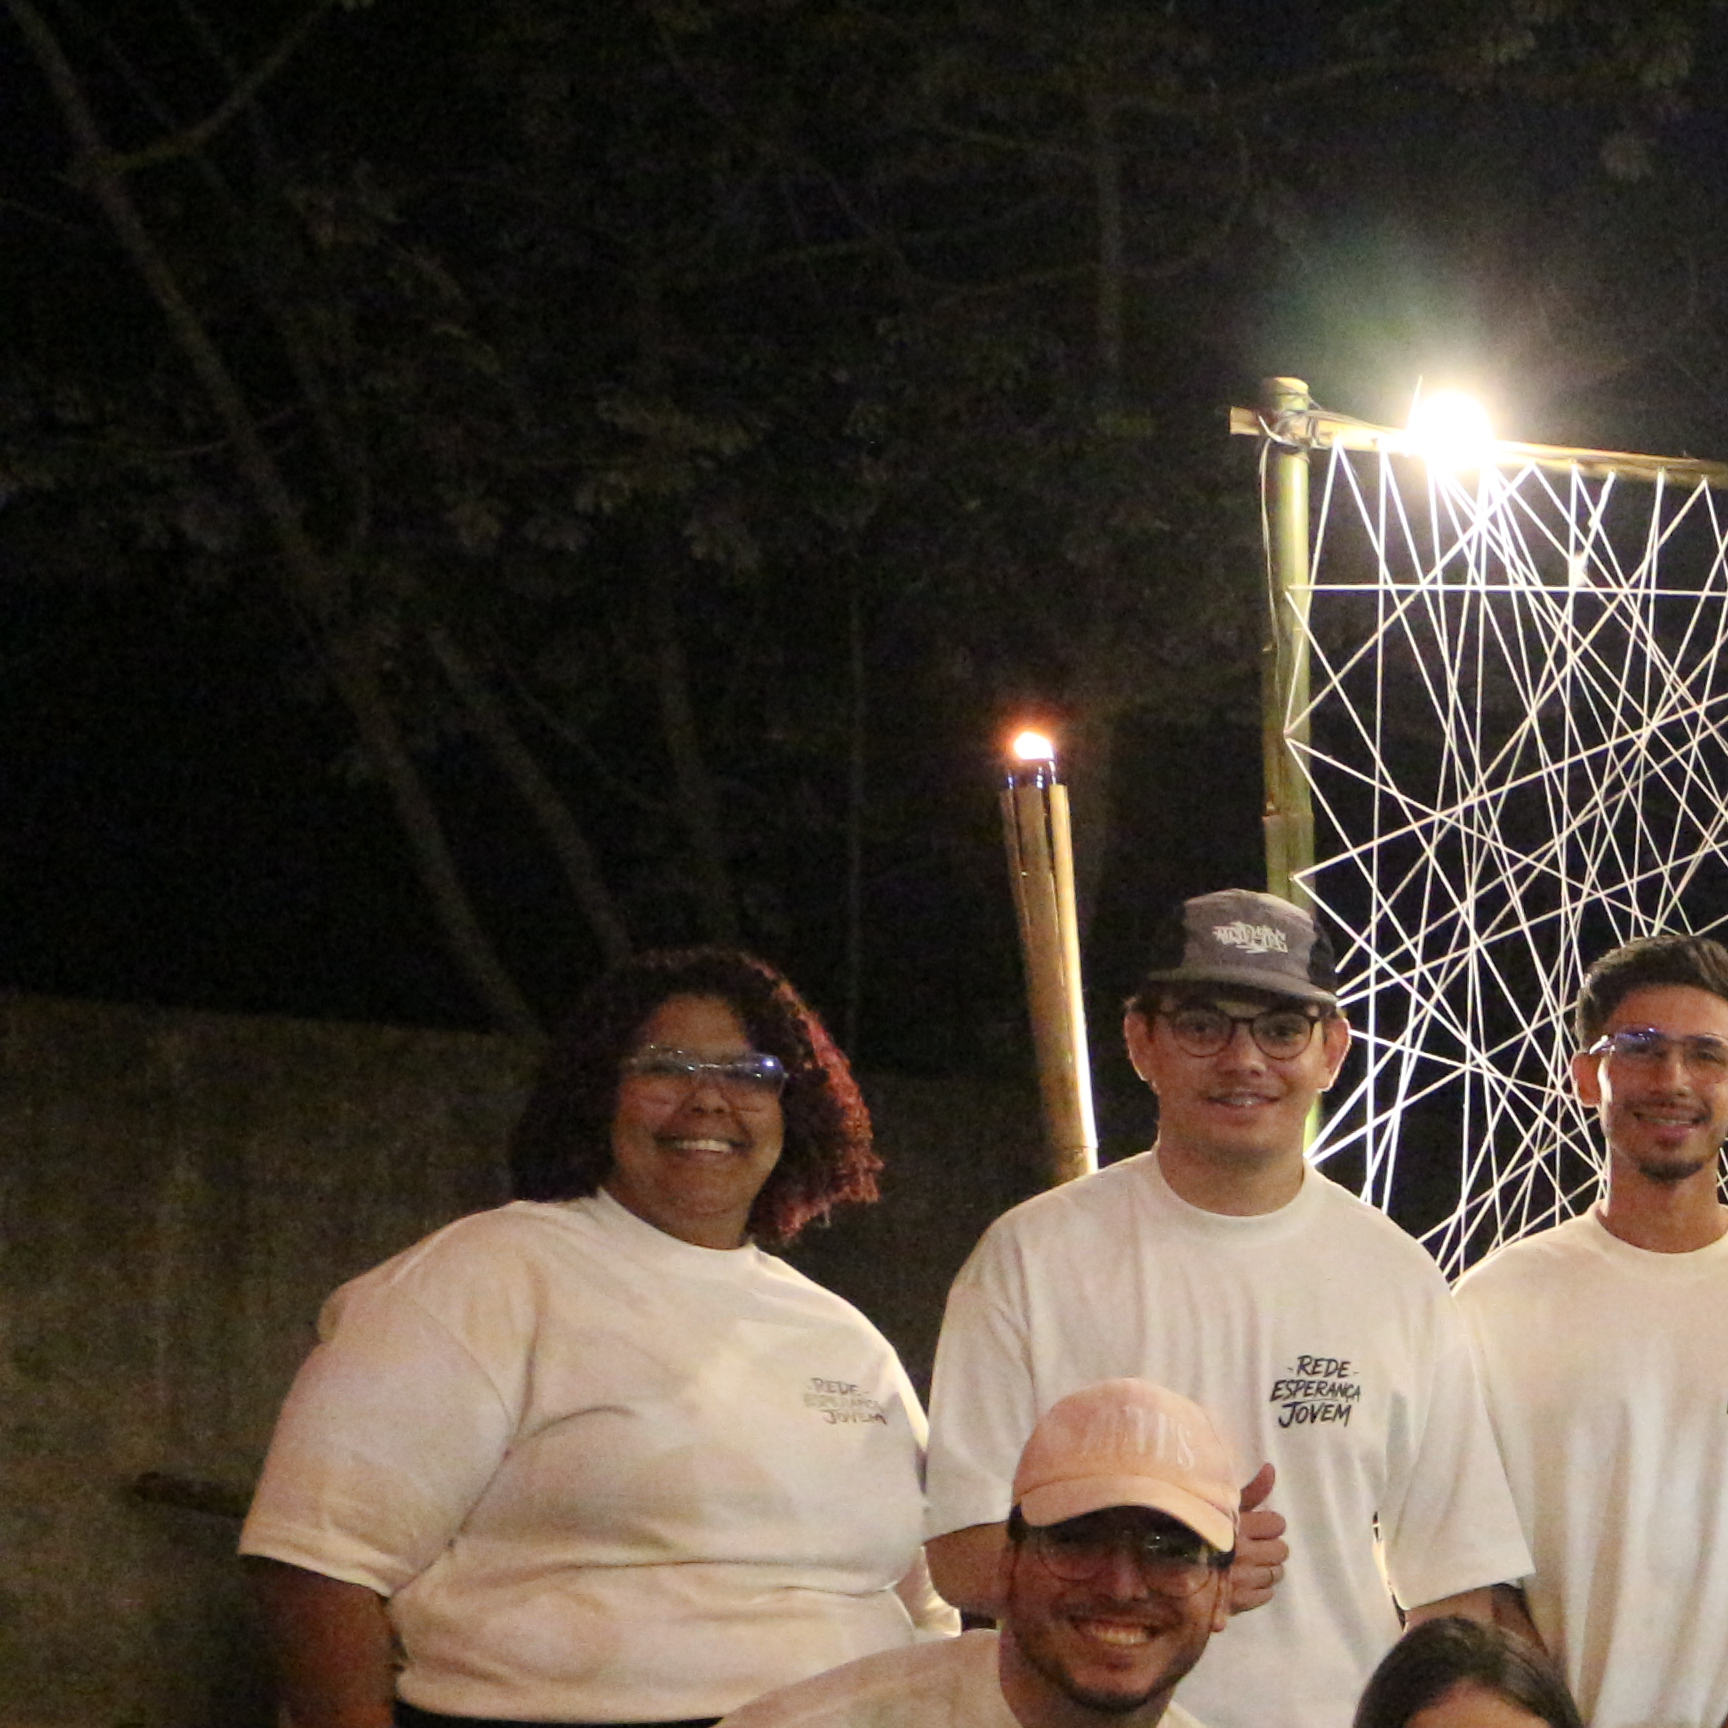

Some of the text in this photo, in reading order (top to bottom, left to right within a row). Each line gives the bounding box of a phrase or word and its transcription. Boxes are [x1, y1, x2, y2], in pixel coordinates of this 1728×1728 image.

[1298, 1354, 1352, 1378] REDE
[811, 1377, 858, 1394] REDE
[1269, 1379, 1361, 1402] ESPERANÇA
[1278, 1401, 1352, 1428] JOVEM
